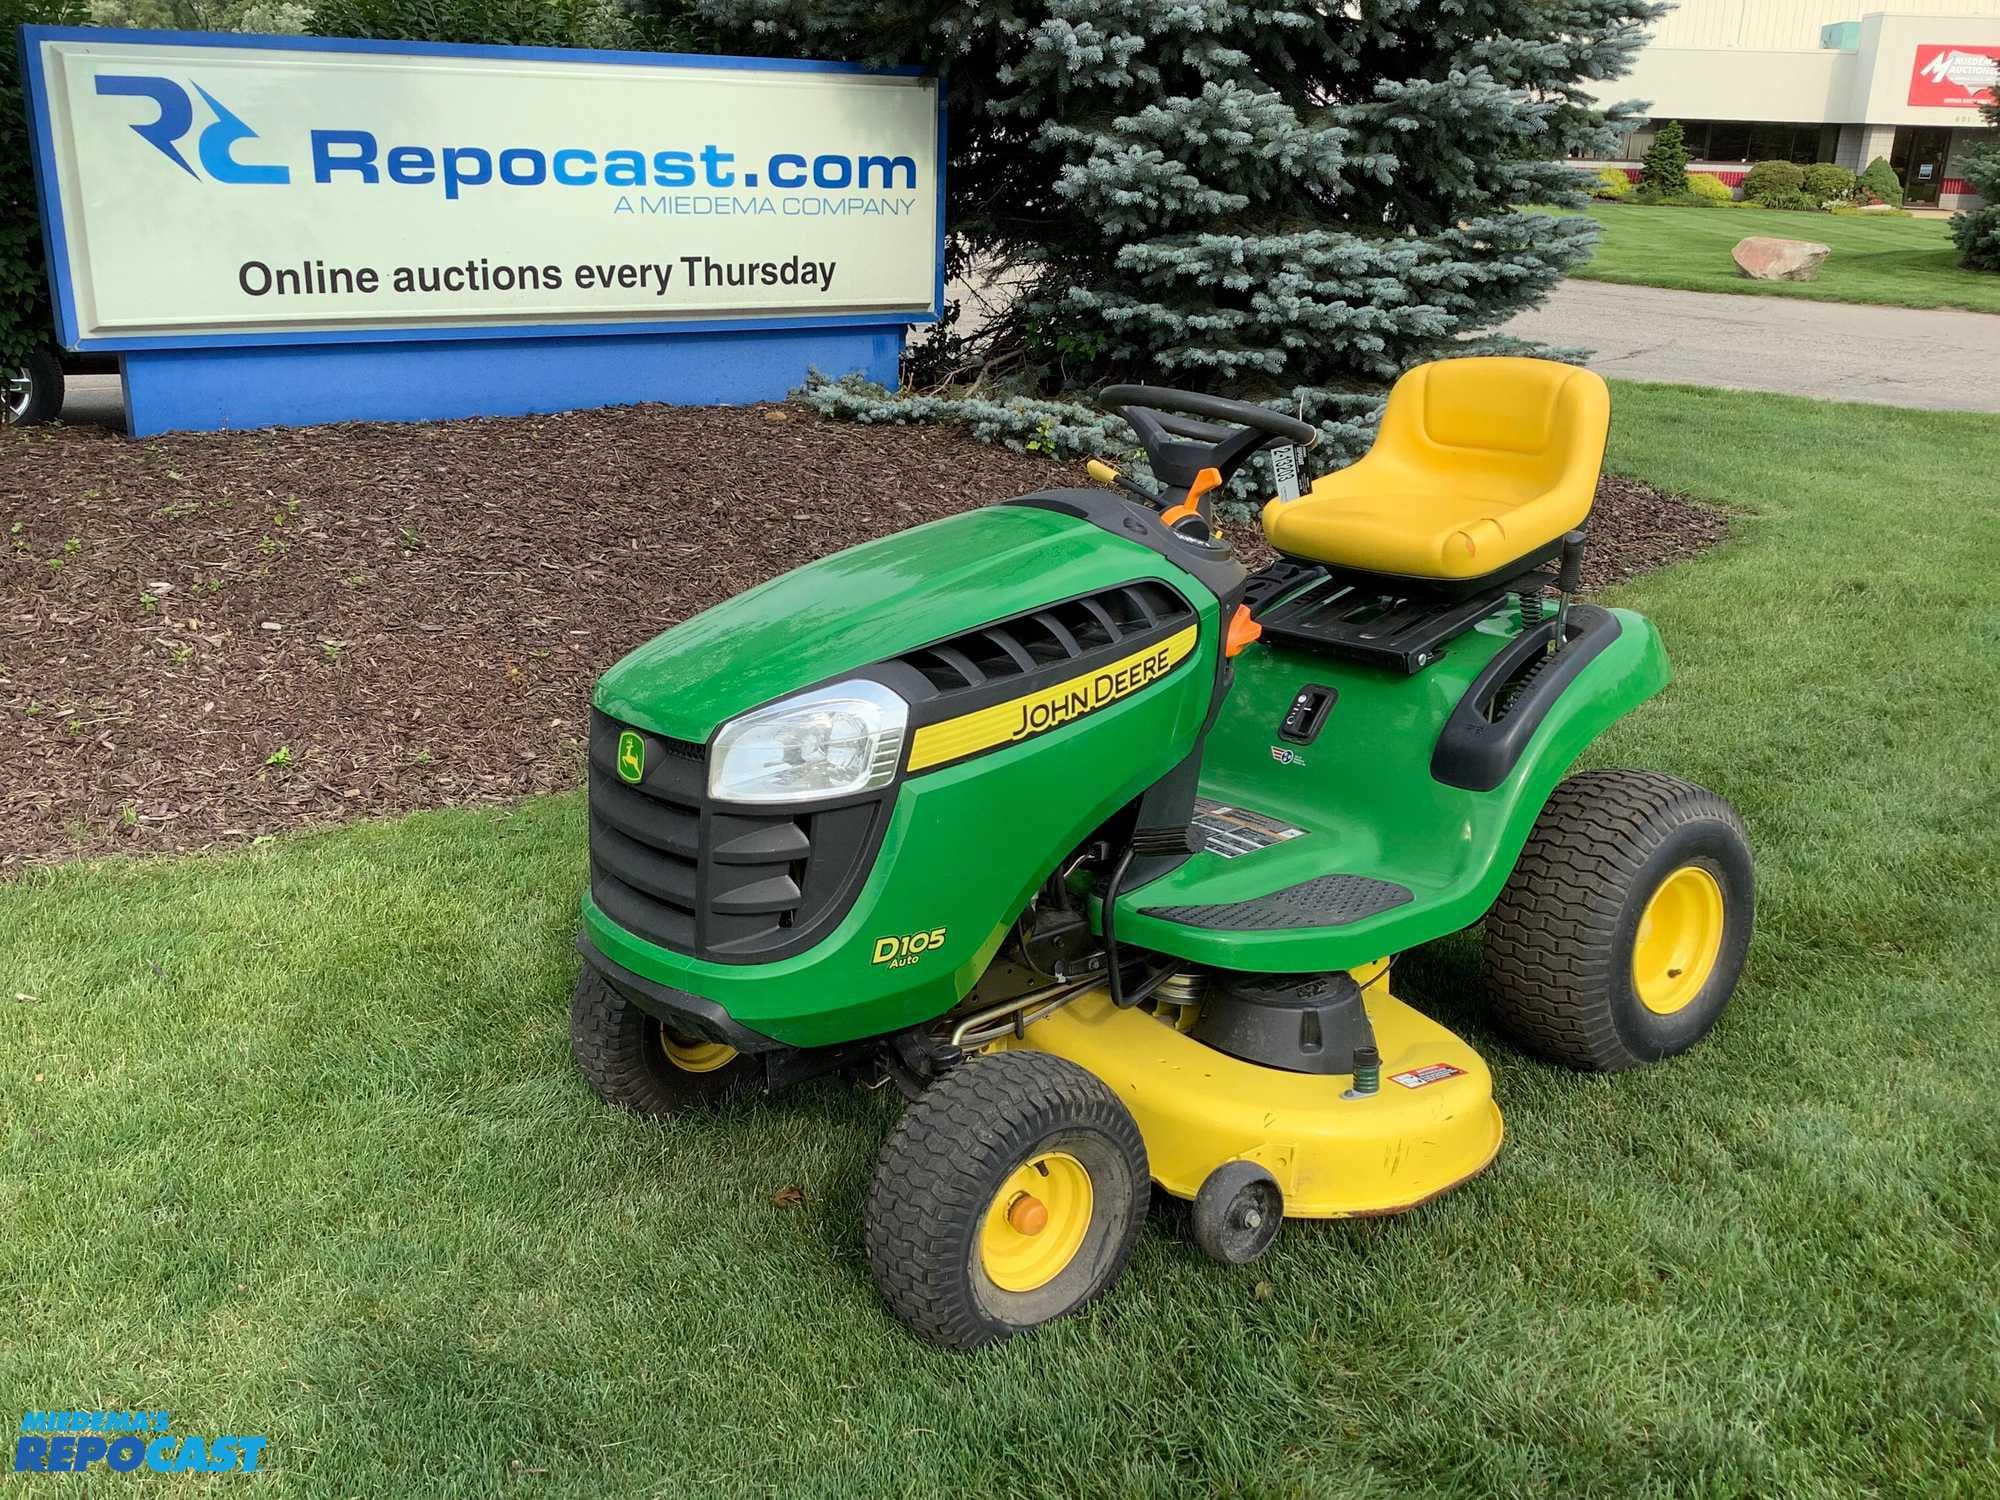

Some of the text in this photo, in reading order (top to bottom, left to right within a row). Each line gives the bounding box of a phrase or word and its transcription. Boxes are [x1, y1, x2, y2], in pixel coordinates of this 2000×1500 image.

[310, 129, 917, 200] Repocast.com
[613, 195, 917, 216] A MIEDEMA COMPANY
[238, 255, 837, 296] Online auctions every Thursday
[1012, 648, 1171, 736] JOHN DEERE
[871, 927, 948, 965] D105
[888, 955, 920, 969] Auto
